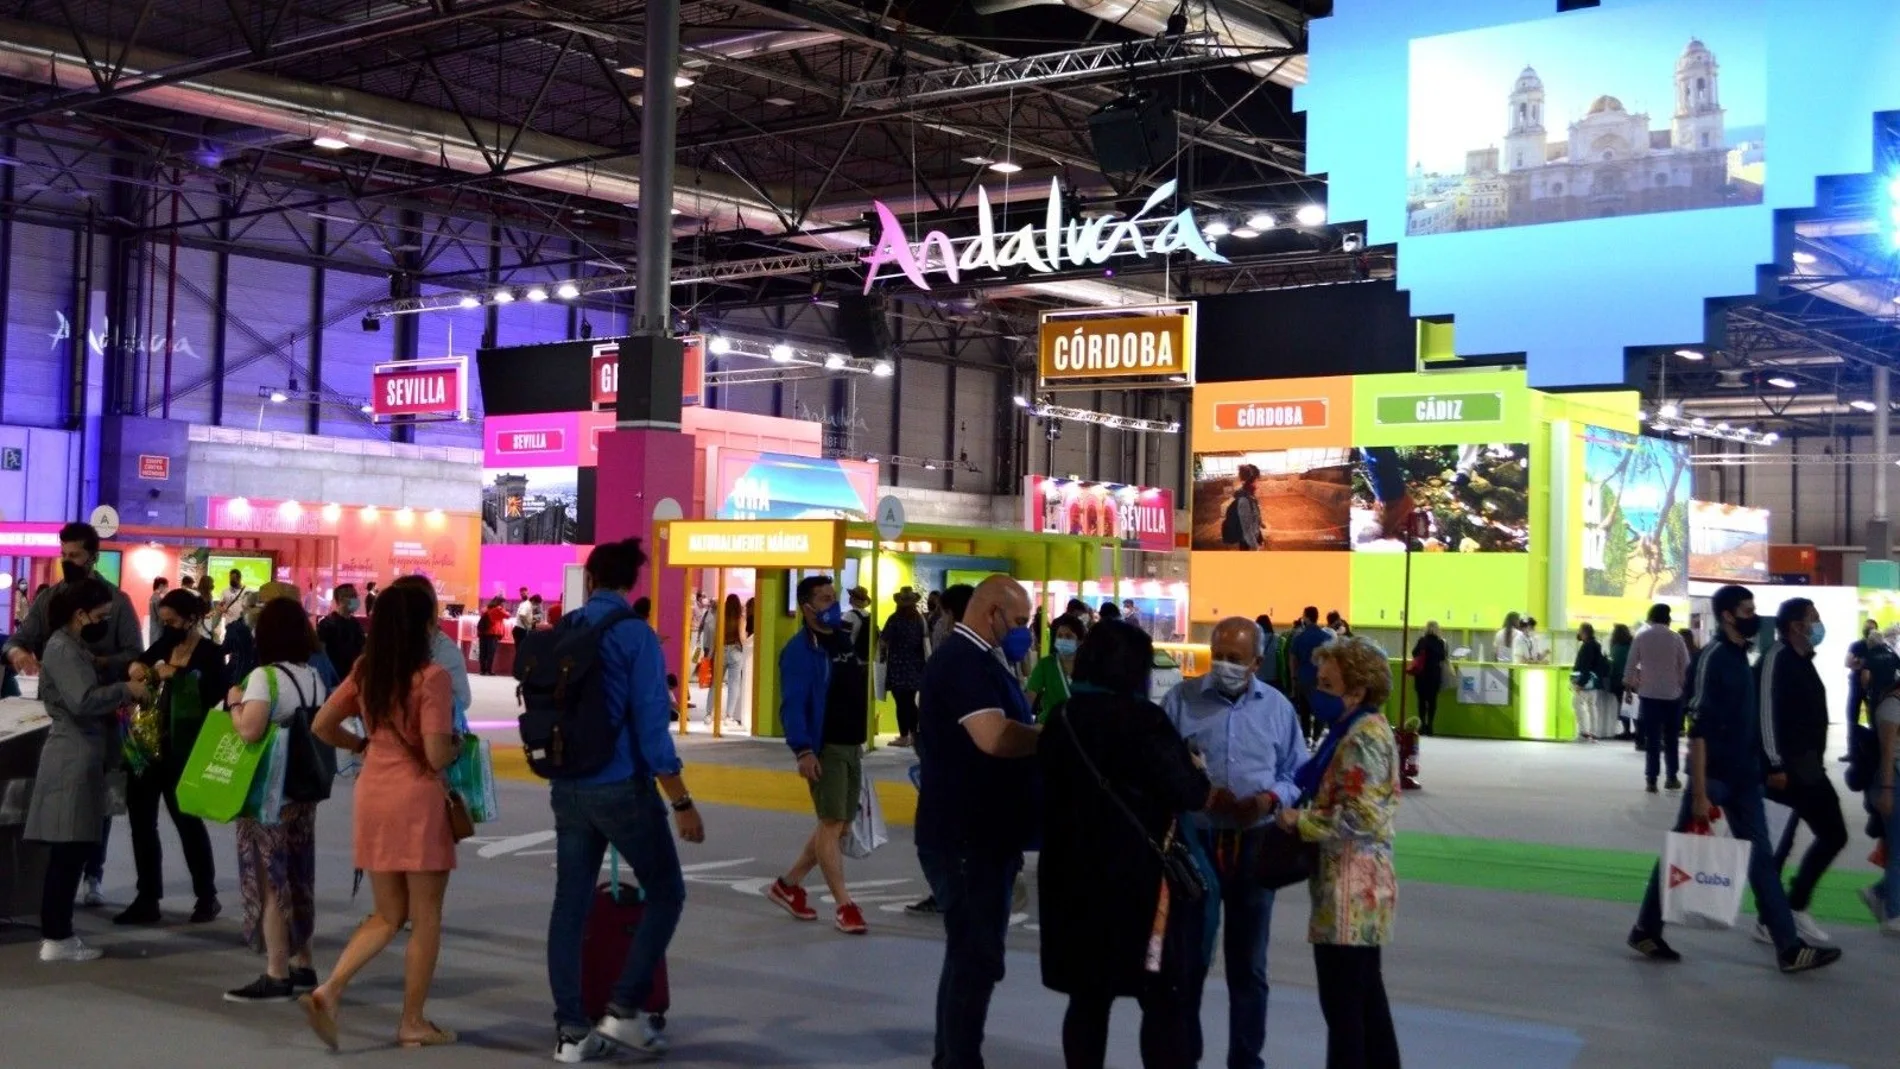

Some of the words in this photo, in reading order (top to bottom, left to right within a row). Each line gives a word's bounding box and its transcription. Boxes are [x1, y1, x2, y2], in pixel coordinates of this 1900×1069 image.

[860, 176, 1231, 296] Andalucía
[1054, 326, 1173, 371] CÓRDOBA
[386, 376, 446, 406] SEVILLA
[1237, 404, 1303, 427] CÓRDOBA
[1415, 397, 1463, 421] CÁDIZ
[512, 433, 547, 450] SEVILLA
[1120, 505, 1166, 533] SEVILLA
[1695, 871, 1731, 887] Cuba
